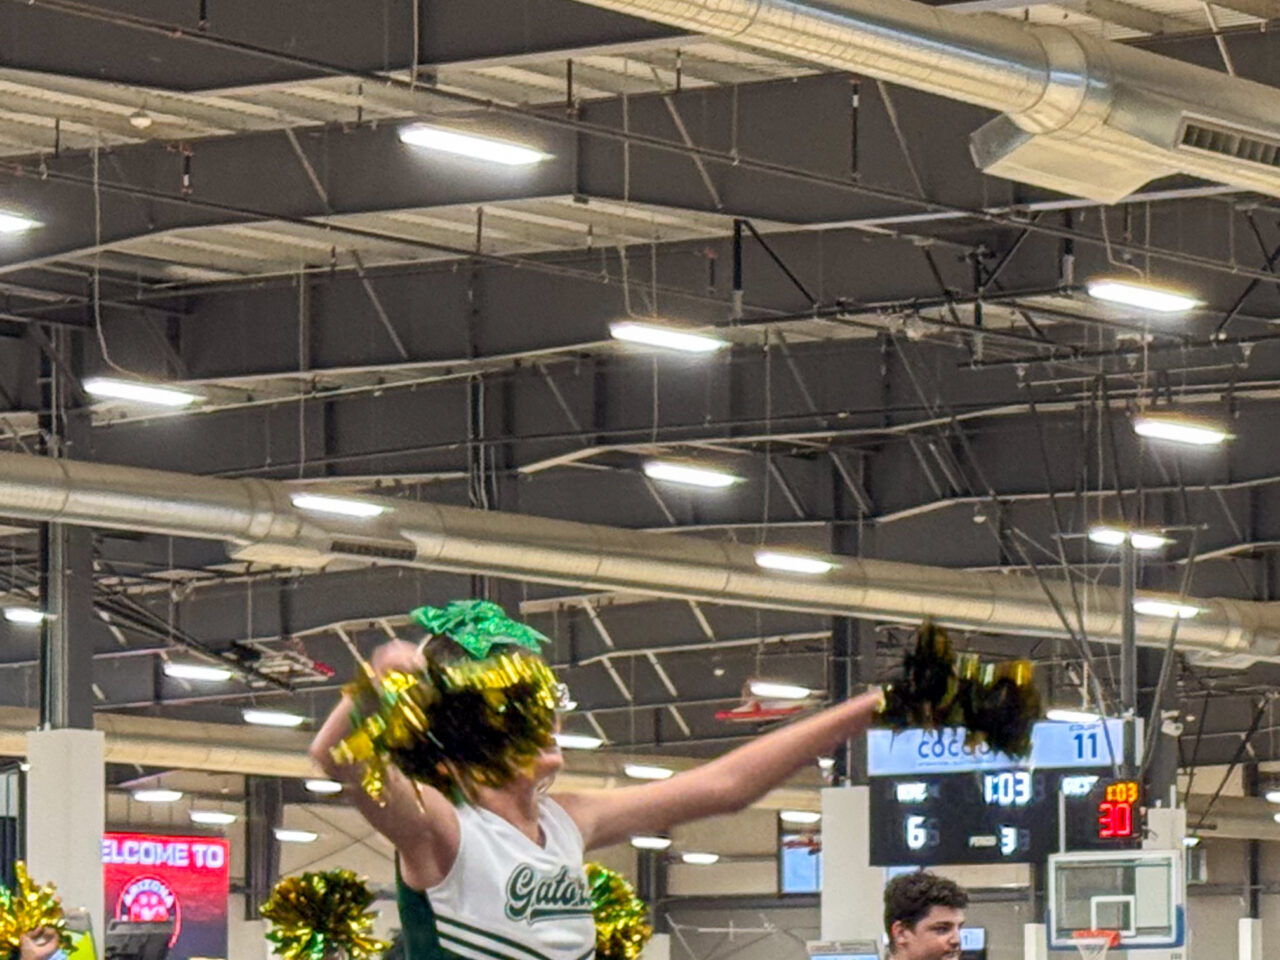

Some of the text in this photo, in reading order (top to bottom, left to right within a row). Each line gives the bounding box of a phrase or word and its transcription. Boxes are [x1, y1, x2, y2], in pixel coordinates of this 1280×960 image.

[1074, 732, 1097, 759] 11
[984, 772, 1031, 806] 1:03
[1106, 782, 1138, 804] 1:03
[906, 815, 927, 850] 6
[1099, 802, 1131, 837] 30
[102, 838, 225, 868] ELCOME TO
[1001, 826, 1017, 856] 3
